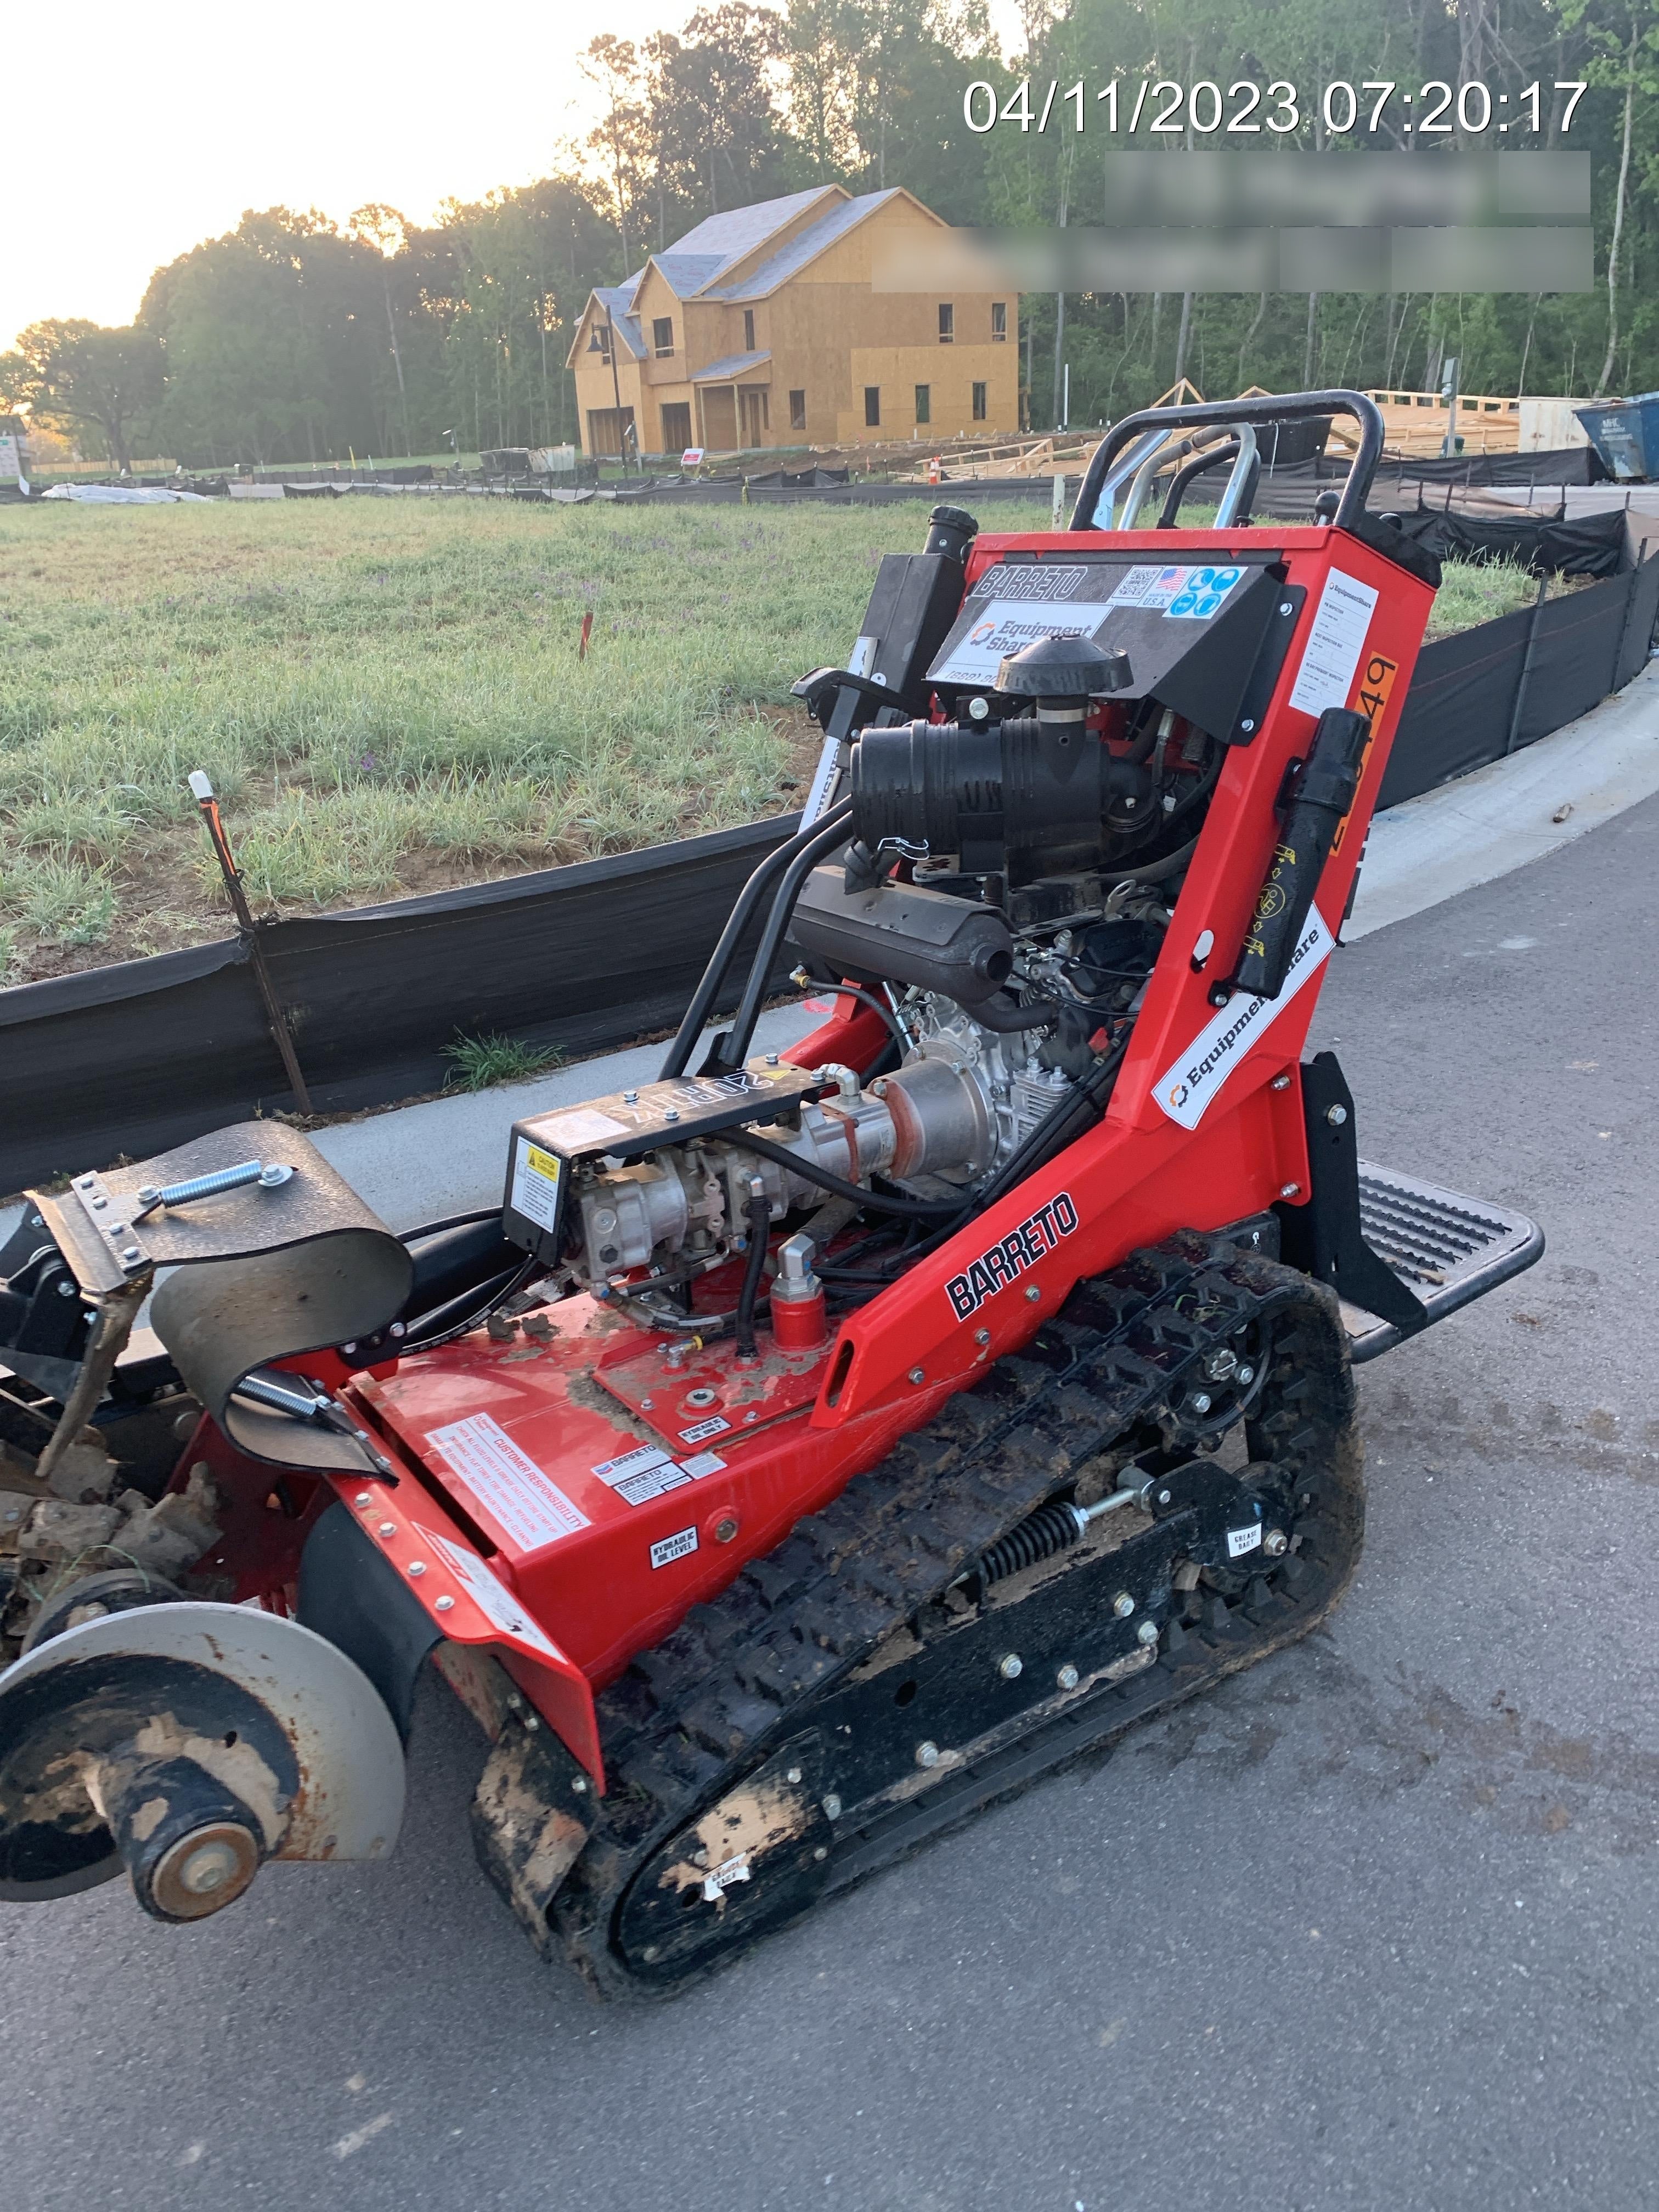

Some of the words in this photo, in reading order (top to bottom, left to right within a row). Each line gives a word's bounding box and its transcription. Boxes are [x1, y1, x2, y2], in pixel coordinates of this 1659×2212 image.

[971, 566, 1088, 600] BARRETO
[1334, 584, 1372, 608] EquipmentShare
[998, 620, 1092, 639] Equipment
[1186, 929, 1319, 1087] Equipmeare
[944, 1191, 1079, 1323] BARRETO
[681, 1418, 721, 1437] HYDRAULIC
[702, 1424, 723, 1434] ONLY
[610, 1444, 657, 1466] BARRETO
[430, 1432, 447, 1448] DAMA
[447, 1453, 471, 1475] EQUIPMENT
[467, 1476, 487, 1494] BATTERY
[482, 1493, 513, 1523] MAINTENANCE
[510, 1524, 534, 1547] CLEANING
[492, 1438, 532, 1474] CUSTOMER
[523, 1471, 586, 1530] RESPONSIBILITY
[617, 1469, 662, 1491] BARRETO
[481, 1454, 498, 1469] LEVELS
[497, 1471, 515, 1486] GREASE
[510, 1485, 526, 1498] DAILY
[535, 1513, 553, 1527] START
[548, 1526, 558, 1534] UP
[514, 1508, 540, 1532] REFUELING
[653, 1531, 693, 1555] HYDRAULIC
[671, 1541, 692, 1556] LEVEL
[1234, 1530, 1257, 1543] GREASE
